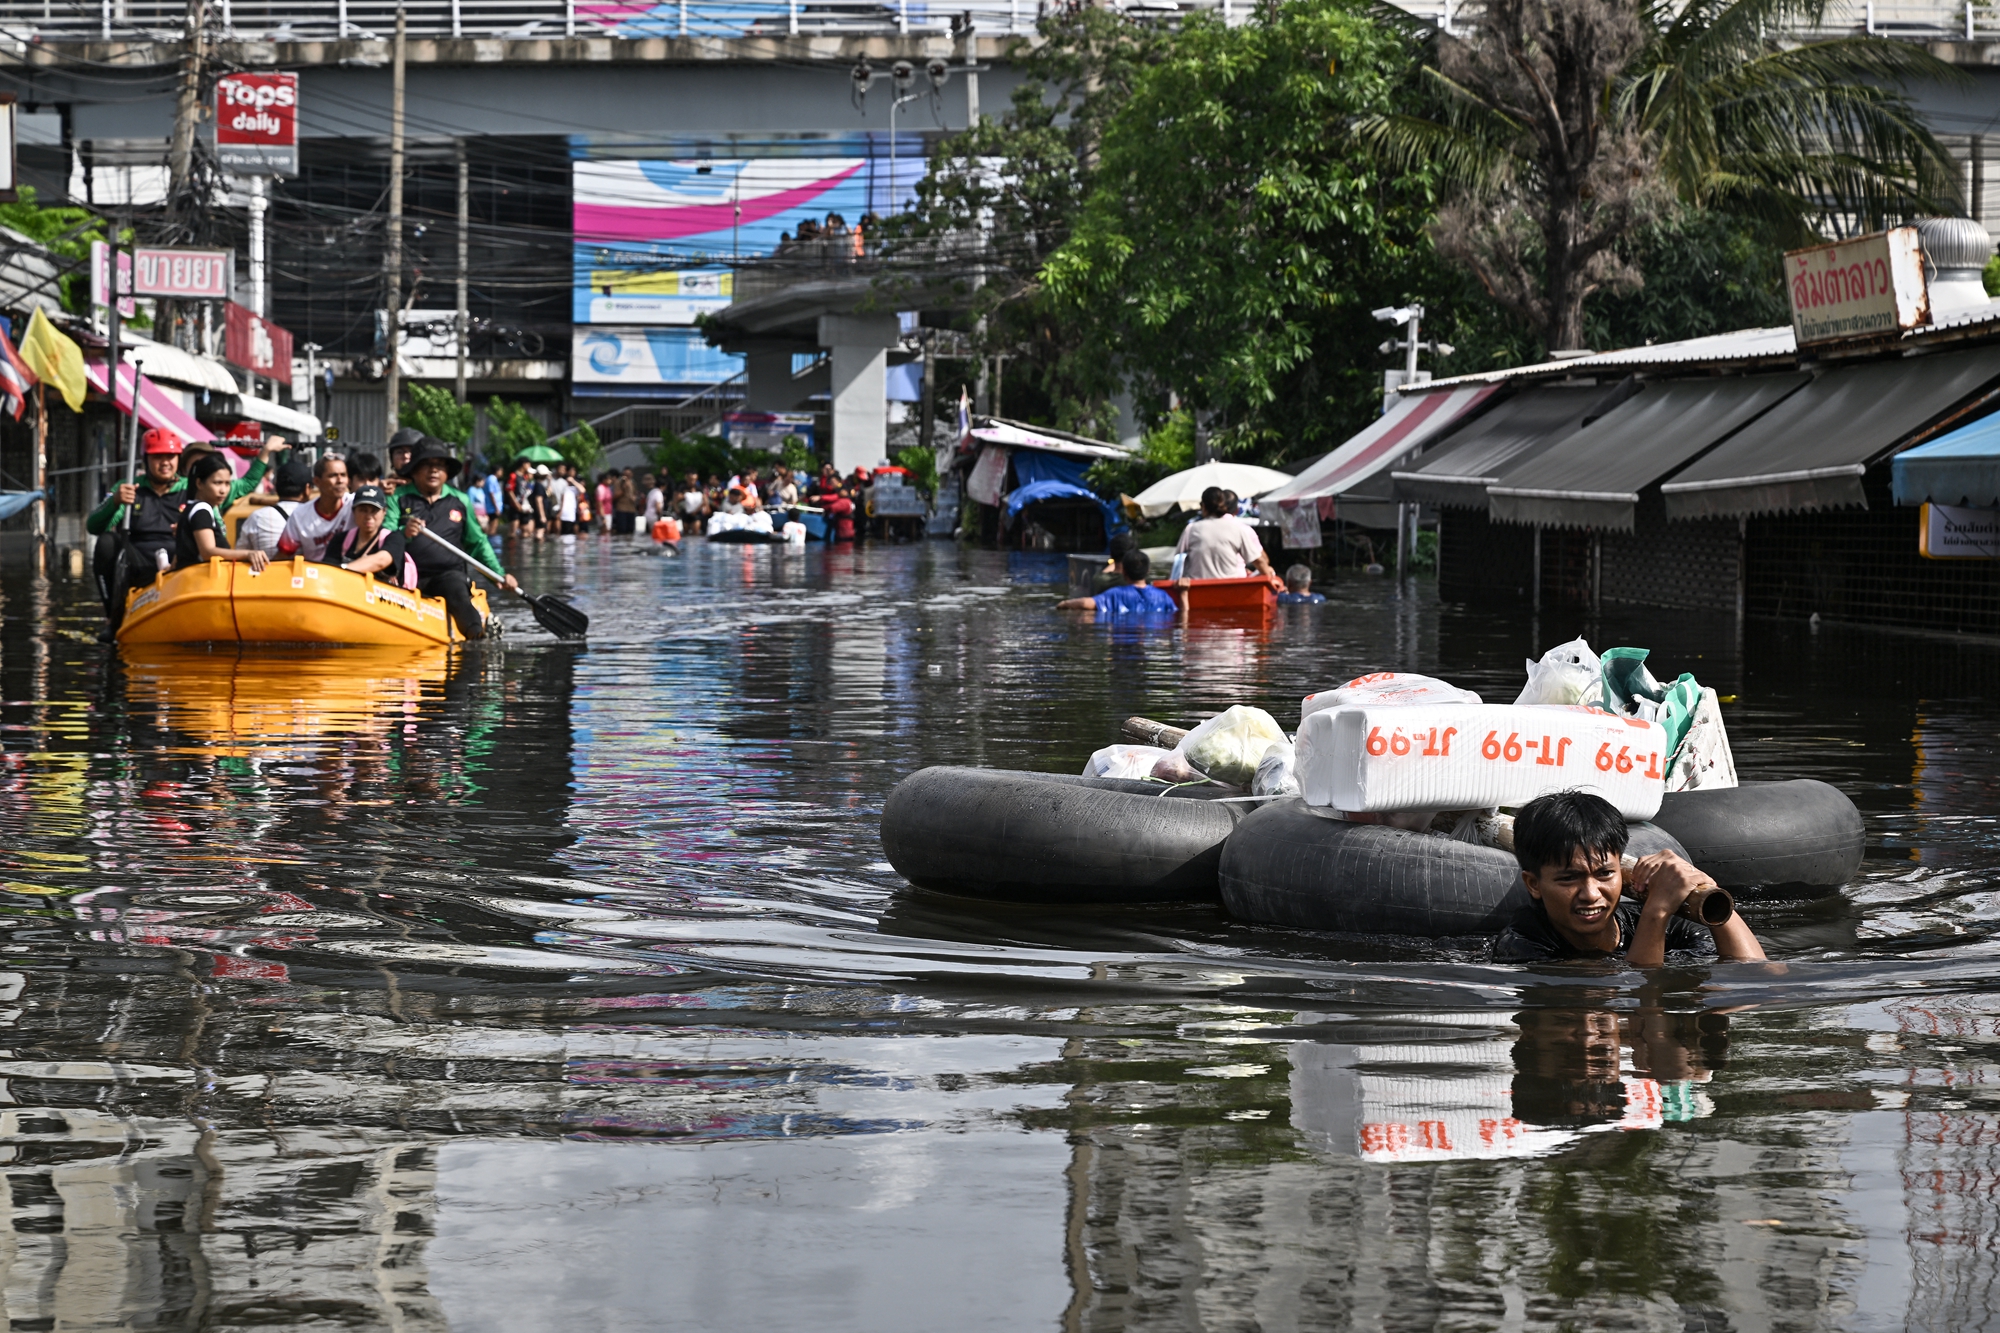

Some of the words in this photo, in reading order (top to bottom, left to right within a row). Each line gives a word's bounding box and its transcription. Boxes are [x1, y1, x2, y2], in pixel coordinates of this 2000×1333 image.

[219, 79, 295, 112] Tops
[232, 111, 280, 135] daily
[138, 255, 225, 290] ขายยา
[1792, 249, 1888, 310] ส้มตำลาว
[1366, 727, 1457, 757] JT-99
[1482, 730, 1572, 767] JT-99
